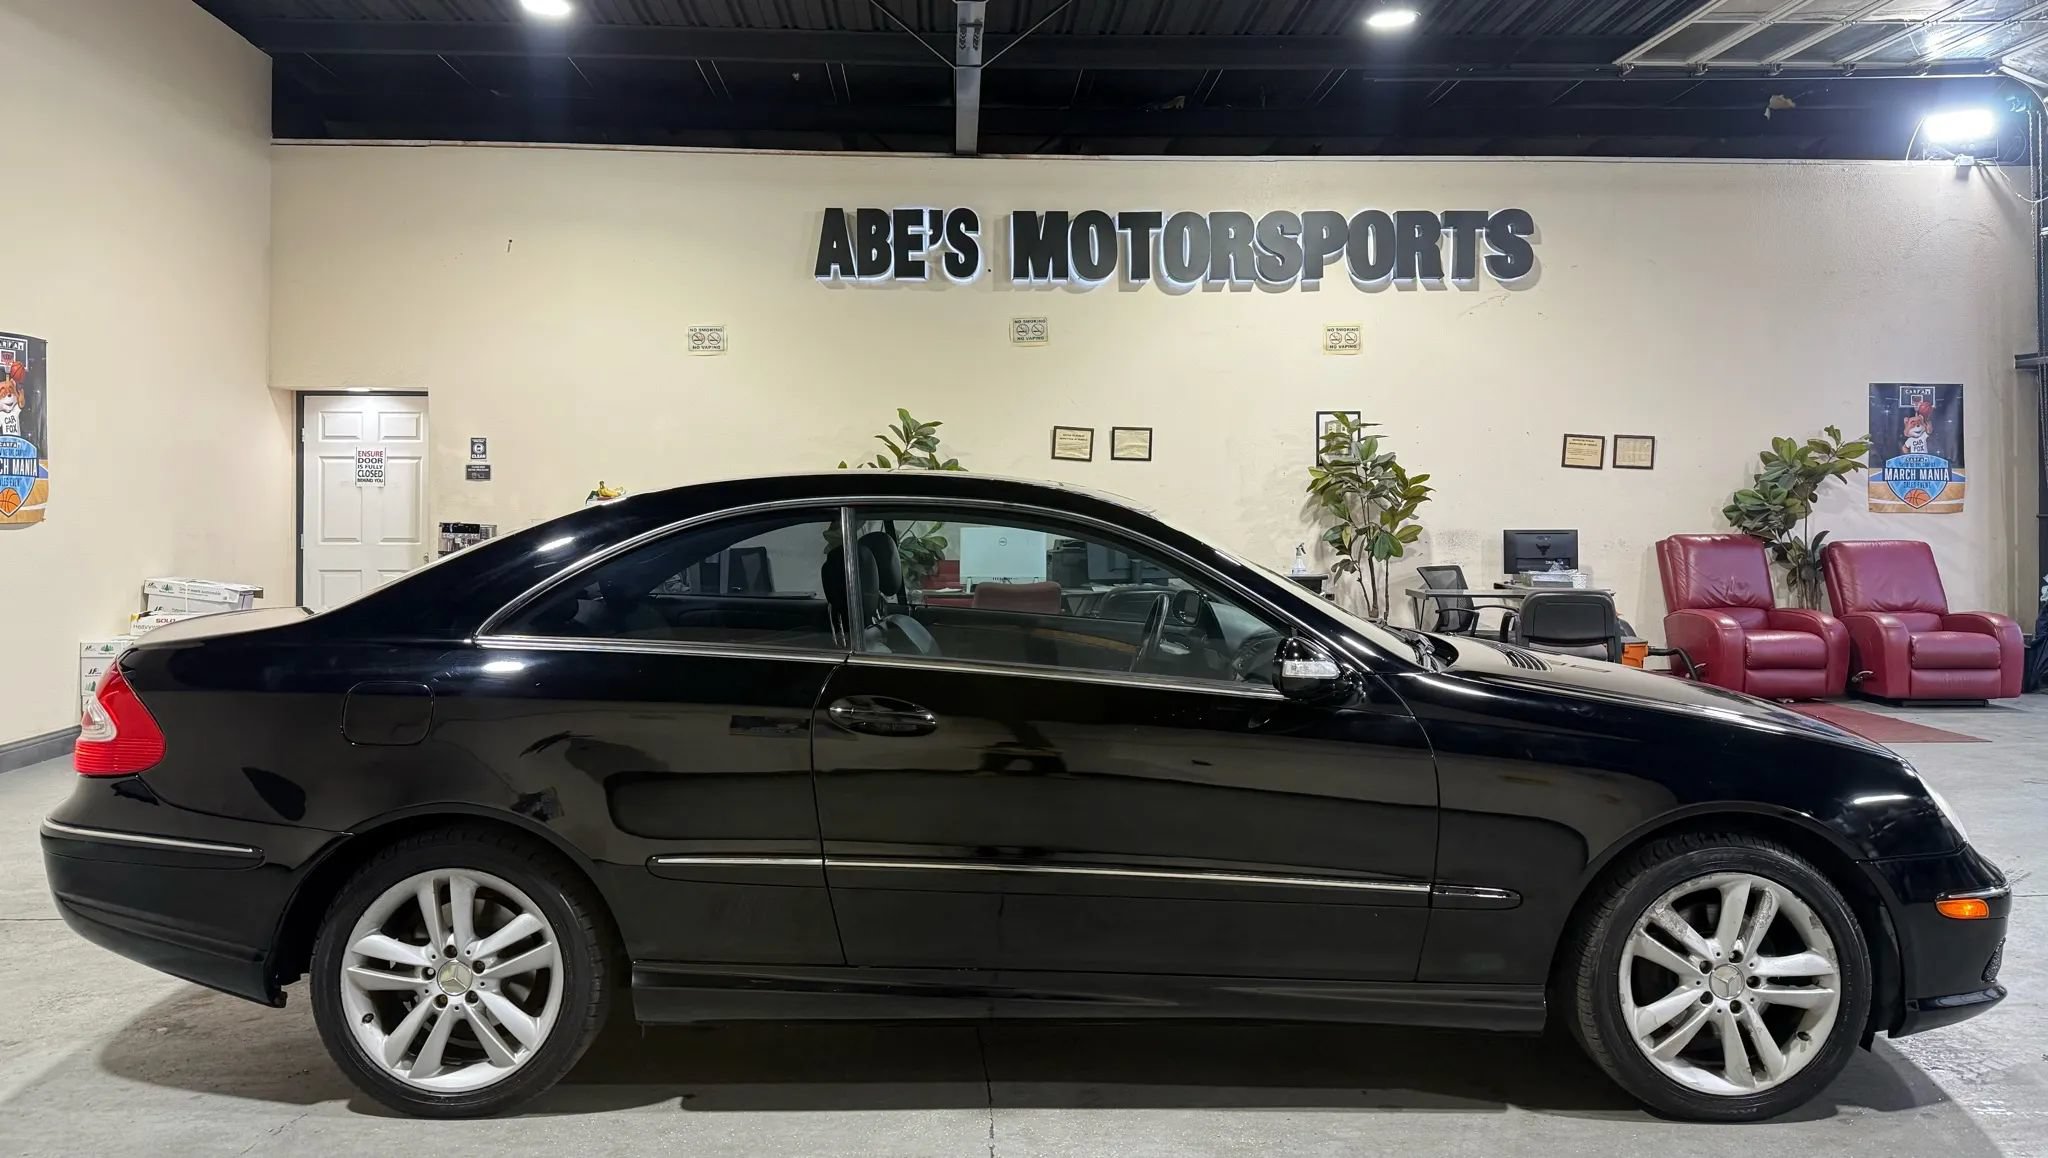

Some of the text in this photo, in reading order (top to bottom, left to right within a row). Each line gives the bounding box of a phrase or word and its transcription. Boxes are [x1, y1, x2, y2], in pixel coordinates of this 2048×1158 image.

[815, 207, 1534, 284] ABE'S MOTORSPORTS
[5, 415, 16, 424] CAR
[5, 424, 17, 433] FOX
[13, 458, 38, 476] MANIA
[1885, 468, 1949, 480] MARCH MANIA
